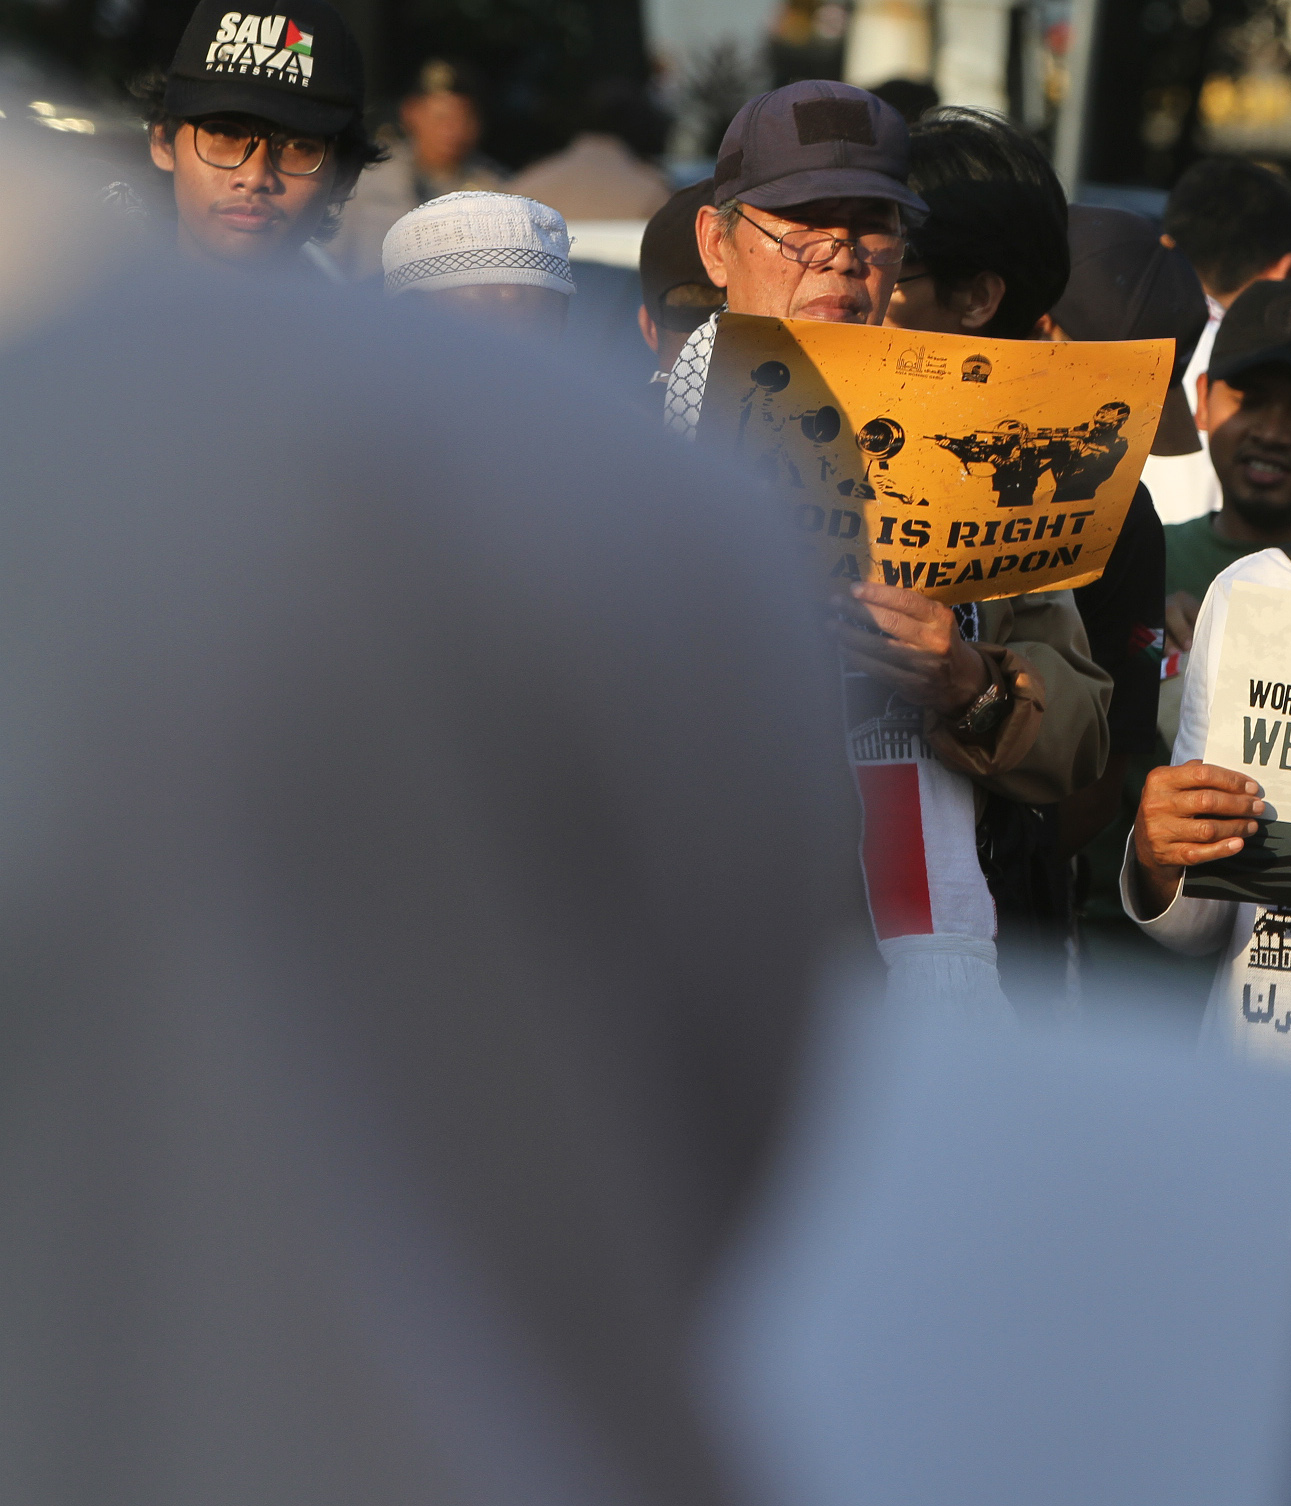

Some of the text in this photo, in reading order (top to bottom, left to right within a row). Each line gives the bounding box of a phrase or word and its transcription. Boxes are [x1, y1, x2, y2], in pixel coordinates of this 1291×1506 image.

[206, 63, 310, 87] PALESTINE
[876, 516, 932, 548] IS
[947, 510, 1095, 548] RIGHT
[830, 544, 1083, 589] A WEAPON
[1242, 983, 1276, 1023] لنا
